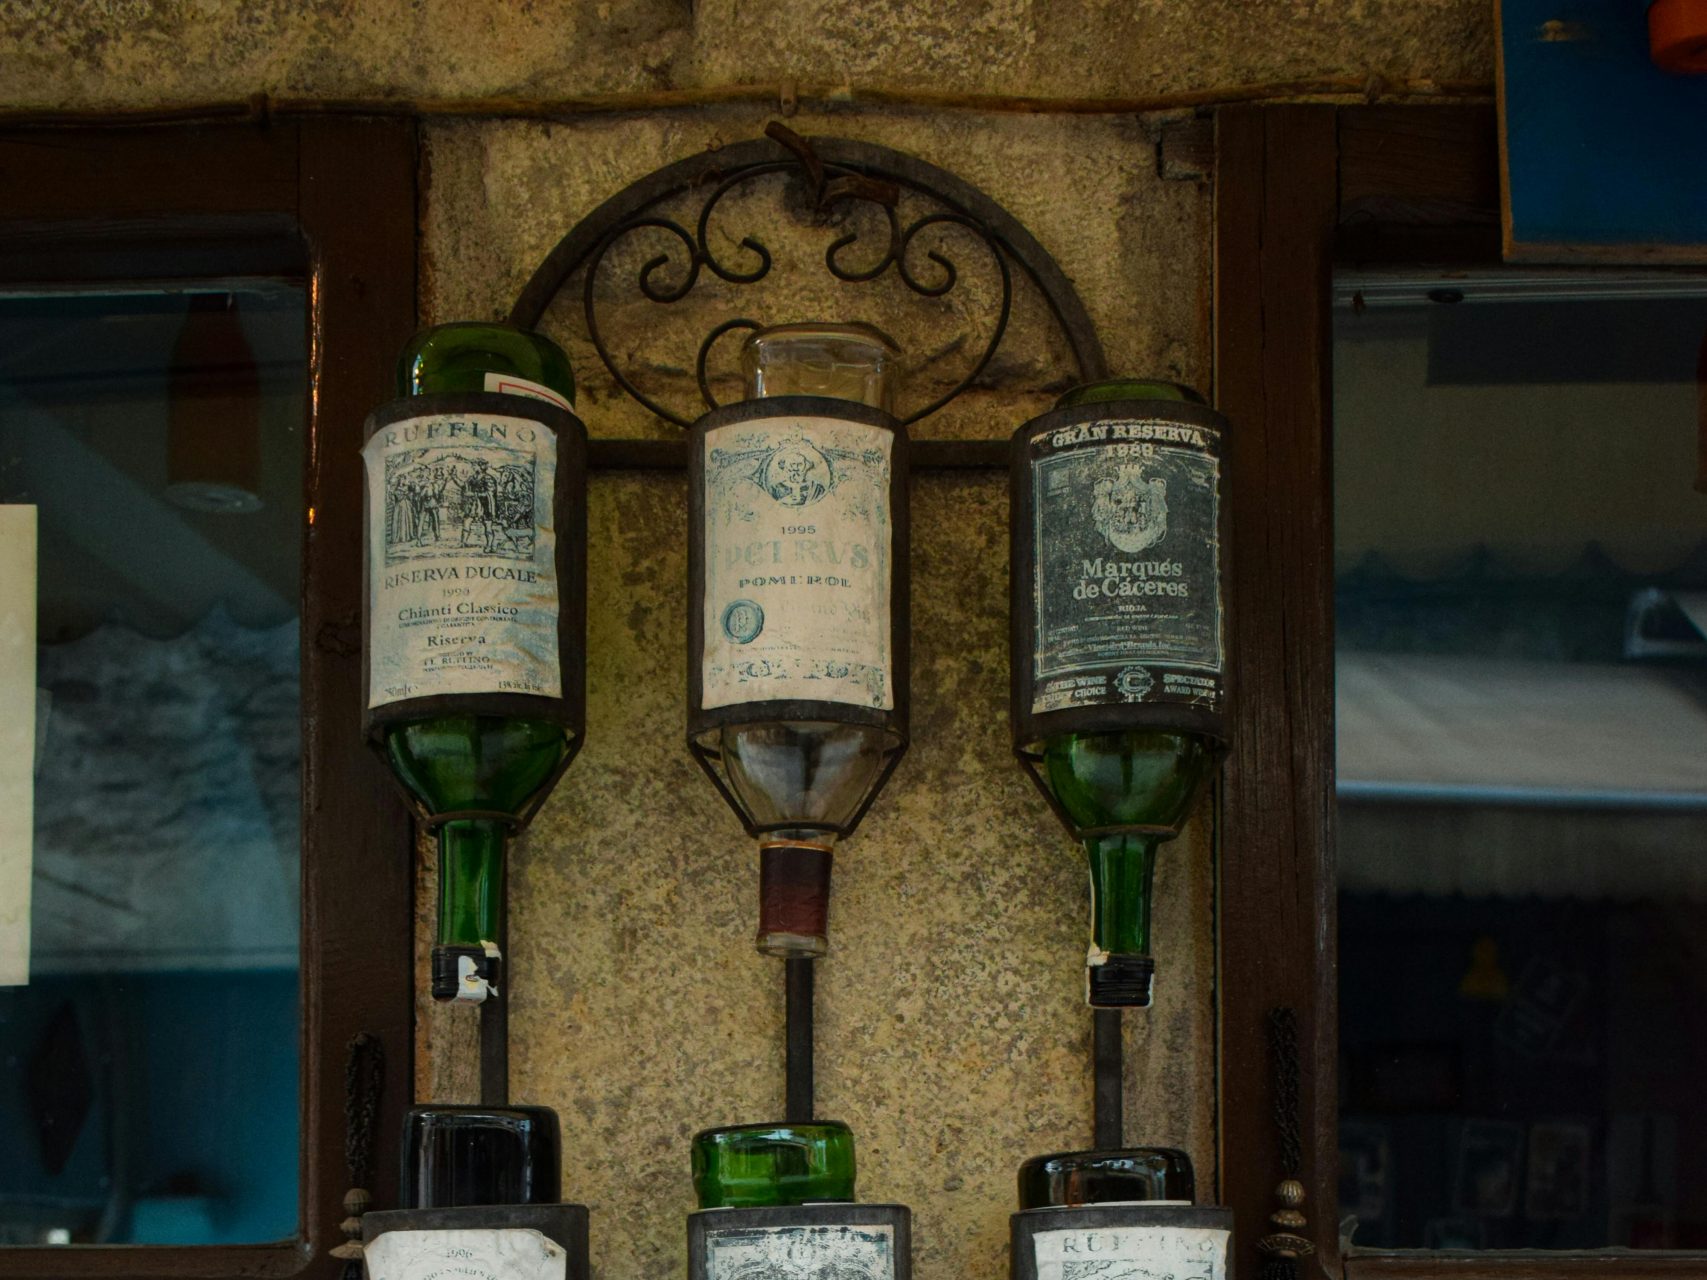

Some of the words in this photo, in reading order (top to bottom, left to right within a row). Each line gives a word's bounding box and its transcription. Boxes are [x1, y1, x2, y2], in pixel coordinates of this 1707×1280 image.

[384, 421, 536, 448] RUFFINO
[1052, 423, 1109, 448] GRAN
[1113, 424, 1207, 448] RESERVA
[781, 525, 816, 535] 1995
[384, 567, 459, 590] RISERVA
[465, 566, 538, 584] DUCALE
[1081, 557, 1183, 580] Marqués
[1073, 580, 1099, 600] de
[1101, 577, 1189, 598] Cáceres
[398, 604, 452, 621] Chianti
[456, 602, 519, 616] Classico
[427, 634, 486, 647] Riserva
